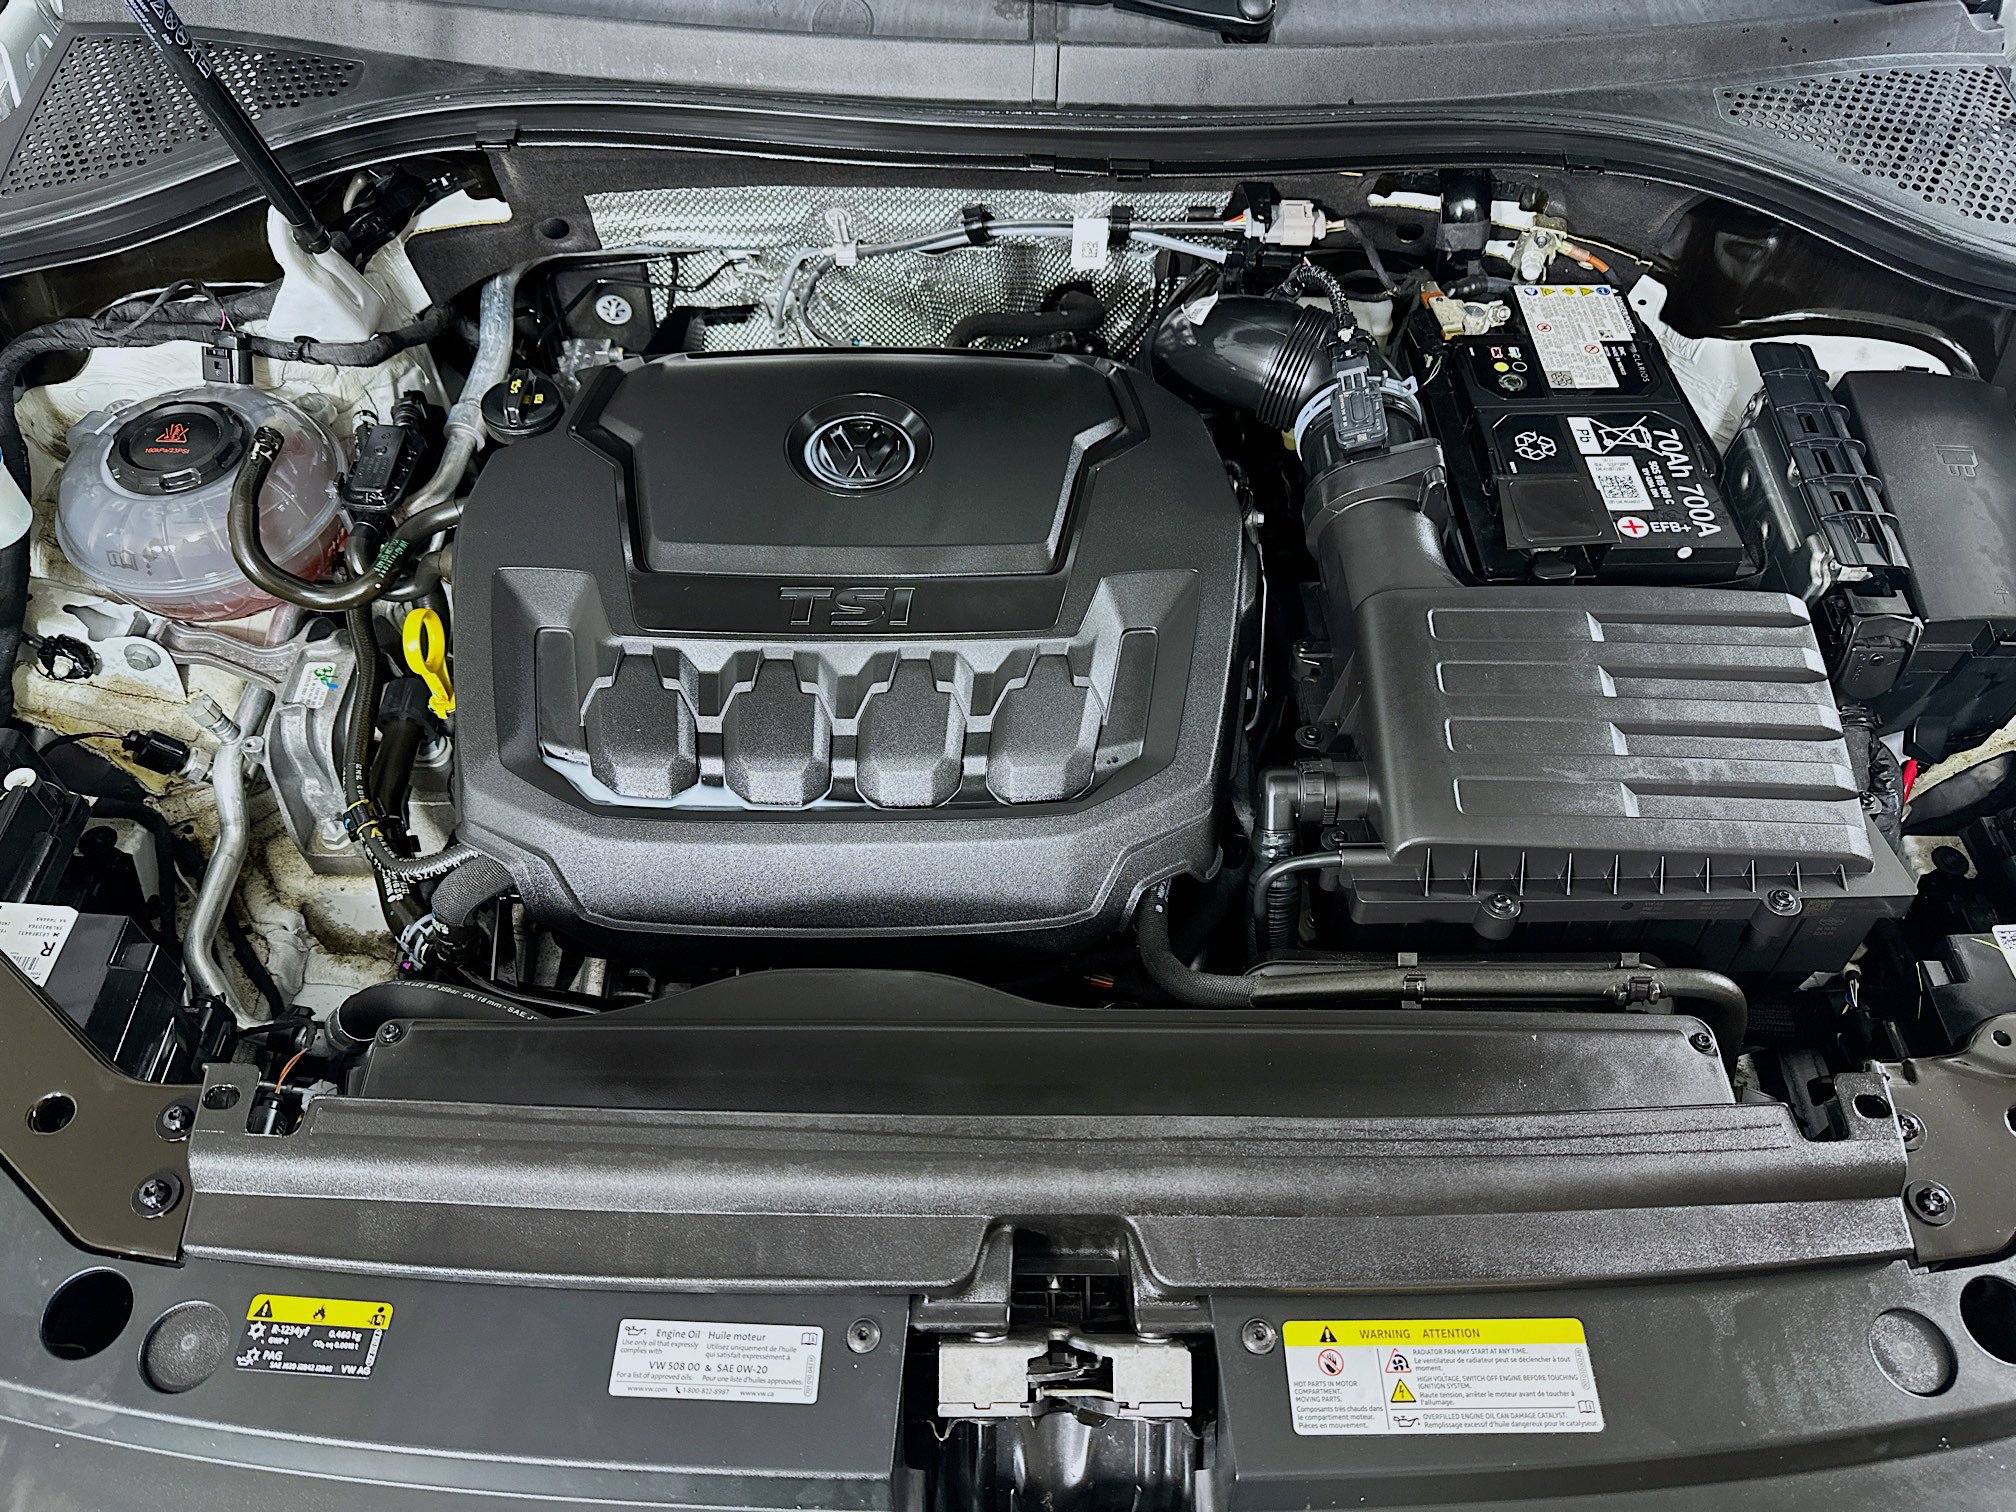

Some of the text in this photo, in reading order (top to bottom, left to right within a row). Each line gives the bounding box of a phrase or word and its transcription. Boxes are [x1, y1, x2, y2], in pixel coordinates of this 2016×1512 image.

[1633, 354, 1650, 382] CLARIOS
[1576, 429, 1590, 442] Pb
[1653, 429, 1721, 537] 70Ah 700A
[1650, 522, 1691, 533] EFB+
[780, 586, 916, 626] TSI
[40, 941, 56, 957] R
[486, 1000, 502, 1008] mm
[507, 1006, 525, 1018] SAE
[352, 1331, 362, 1342] kg
[657, 1329, 700, 1340] Engine Oil
[708, 1331, 731, 1340] Huile
[1359, 1328, 1480, 1339] WARNING ATTENTION
[262, 1350, 283, 1361] PAG
[270, 1361, 282, 1369] SAE
[341, 1364, 356, 1374] VW
[357, 1366, 371, 1376] AG
[649, 1361, 666, 1370] VW
[668, 1362, 685, 1370] 508
[688, 1362, 700, 1371] 00
[717, 1364, 734, 1372] SAE
[736, 1365, 768, 1374] 0W-20
